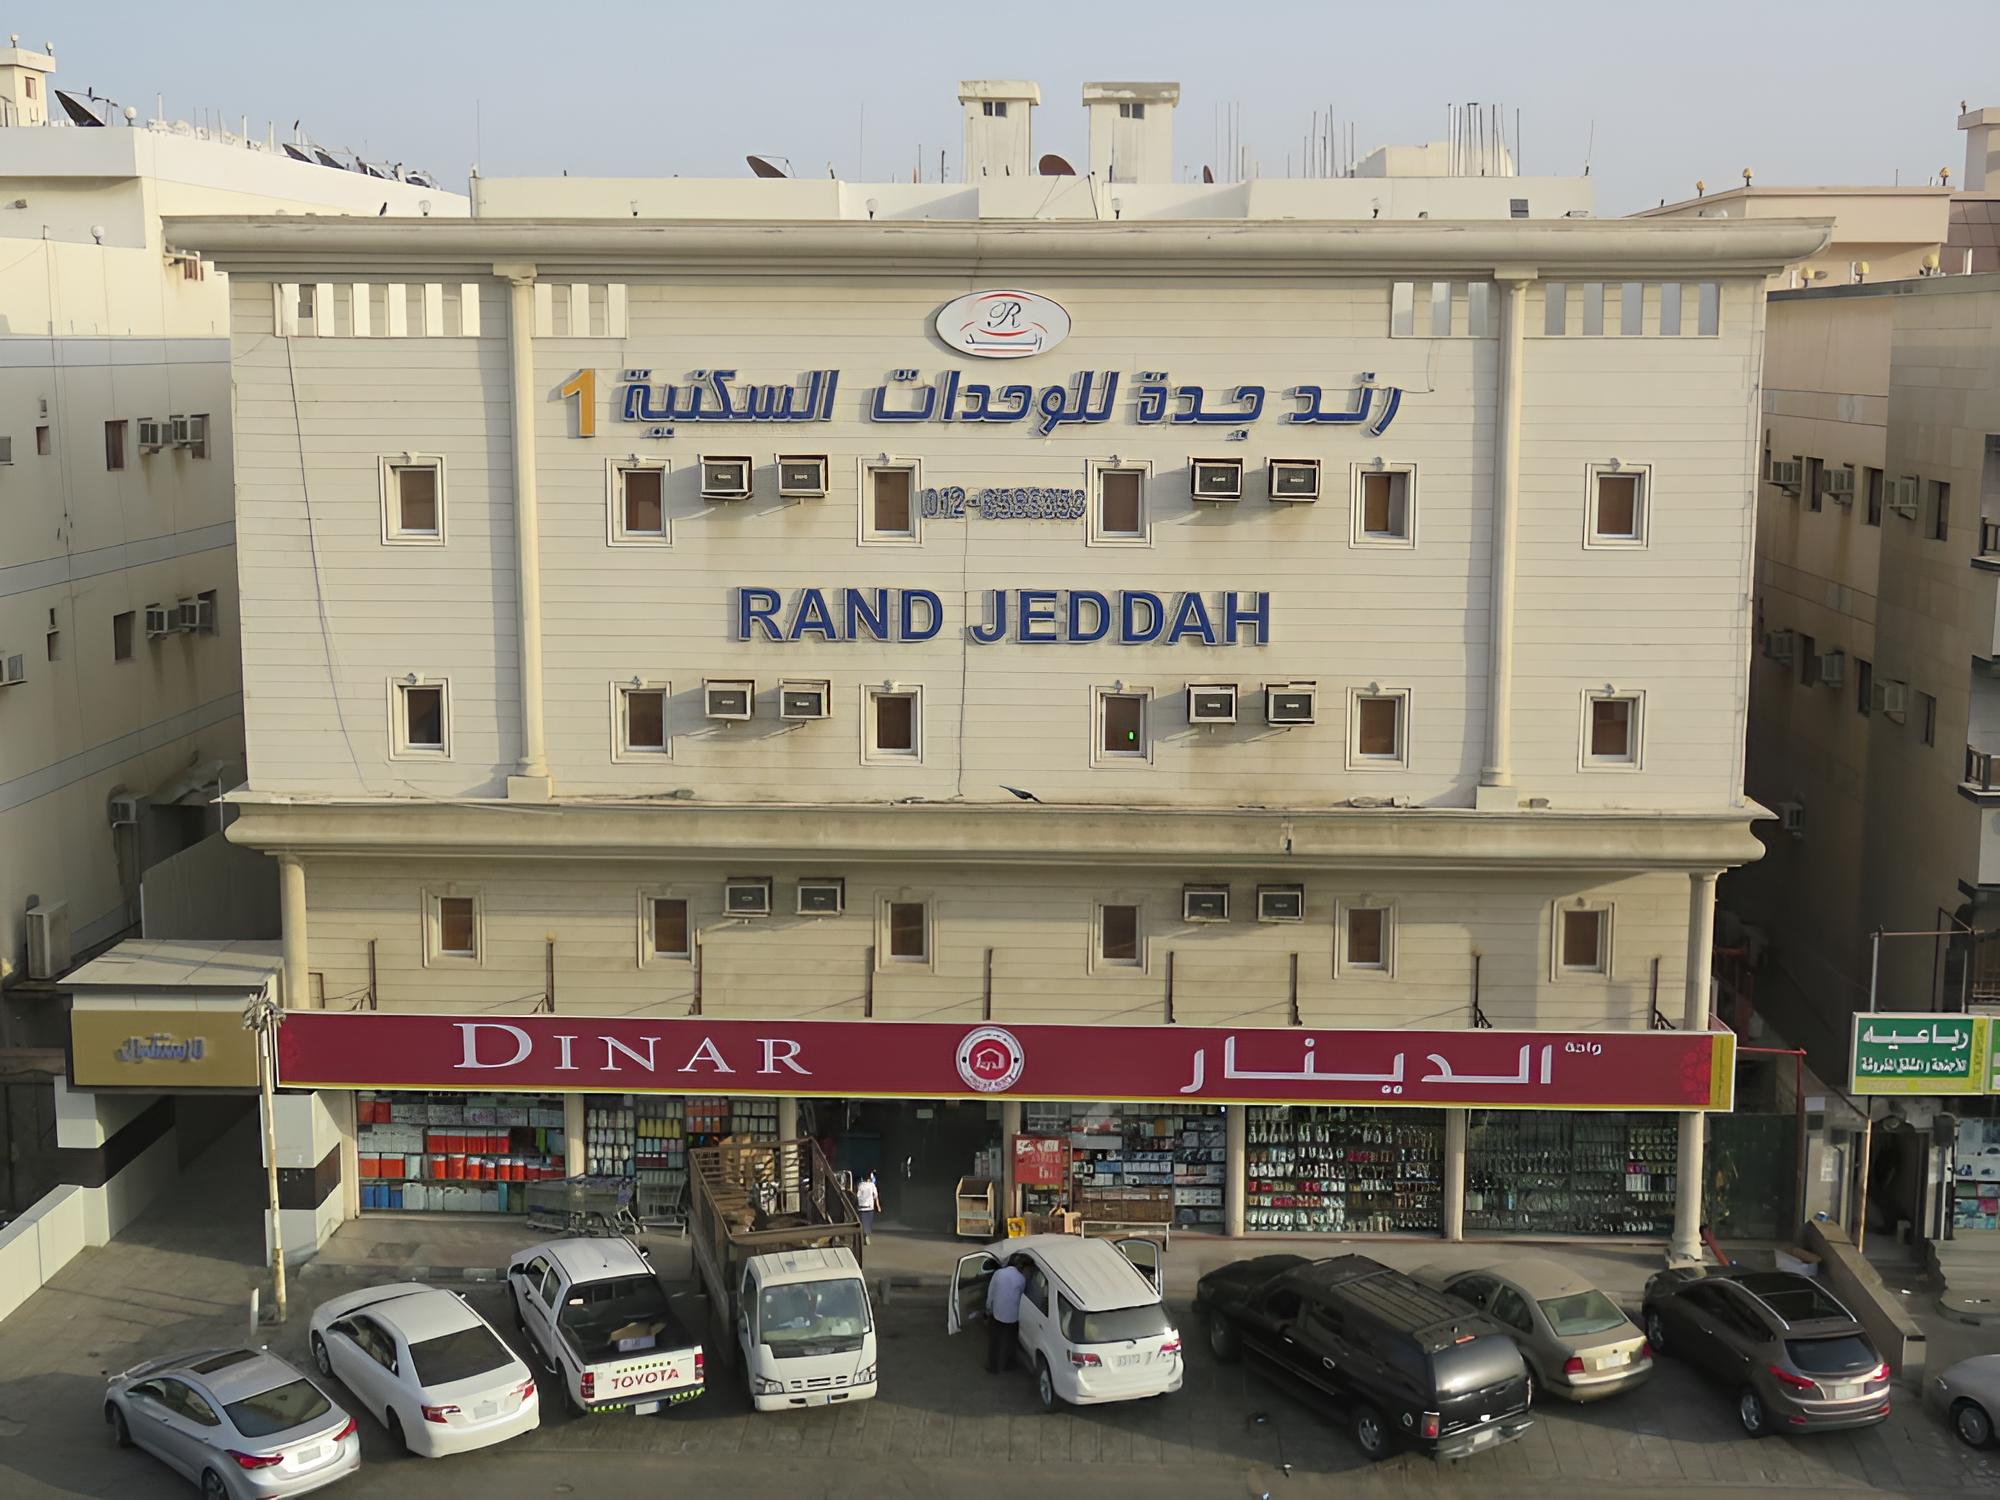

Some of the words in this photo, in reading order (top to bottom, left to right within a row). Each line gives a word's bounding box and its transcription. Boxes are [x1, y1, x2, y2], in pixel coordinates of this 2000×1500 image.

[623, 369, 840, 438] السكنية
[870, 369, 1119, 435] للوحدات
[1137, 371, 1265, 441] جدة
[1288, 372, 1401, 436] رند
[738, 587, 944, 643] RAND
[968, 588, 1270, 645] JEDDAH
[453, 1023, 812, 1075] DINAR
[1180, 1035, 1552, 1094] الدينار
[611, 1368, 679, 1390] TOYOTA
